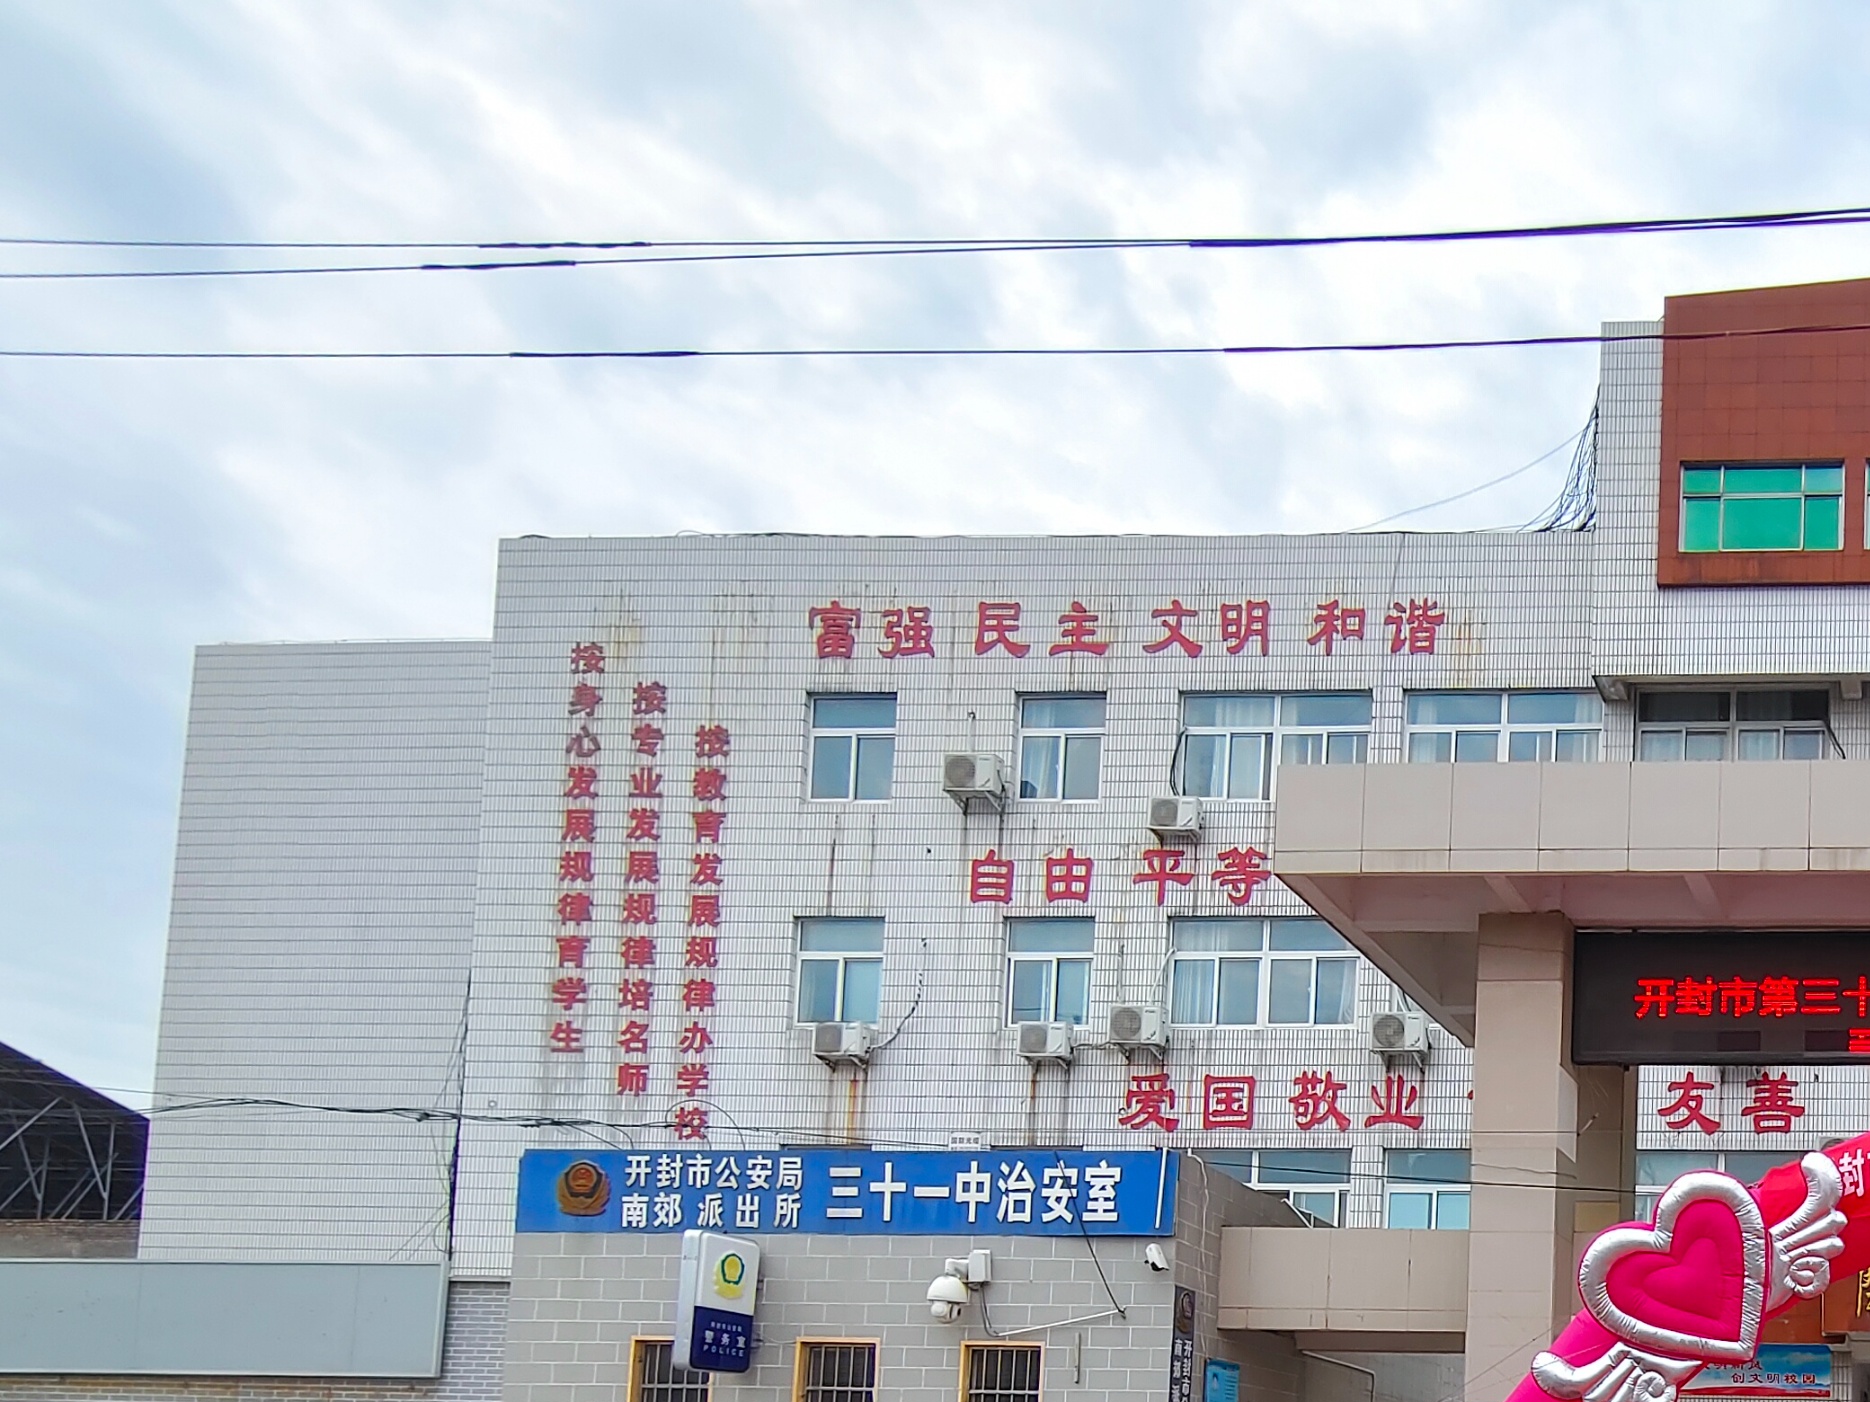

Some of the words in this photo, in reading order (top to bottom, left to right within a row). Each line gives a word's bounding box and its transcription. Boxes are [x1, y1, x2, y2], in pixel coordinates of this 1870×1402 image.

[550, 641, 606, 1053] 按身心发展规律育学生
[616, 681, 668, 1097] 按专业发展规律培名师
[674, 725, 731, 1140] 按教育发展规律办学校
[1658, 1071, 1805, 1135] 友善
[625, 1153, 803, 1191] 开封市公安局
[827, 1159, 1122, 1224] 三十一中治安室
[702, 1344, 745, 1358] POLICE
[1731, 1373, 1816, 1384] 创文明校园
